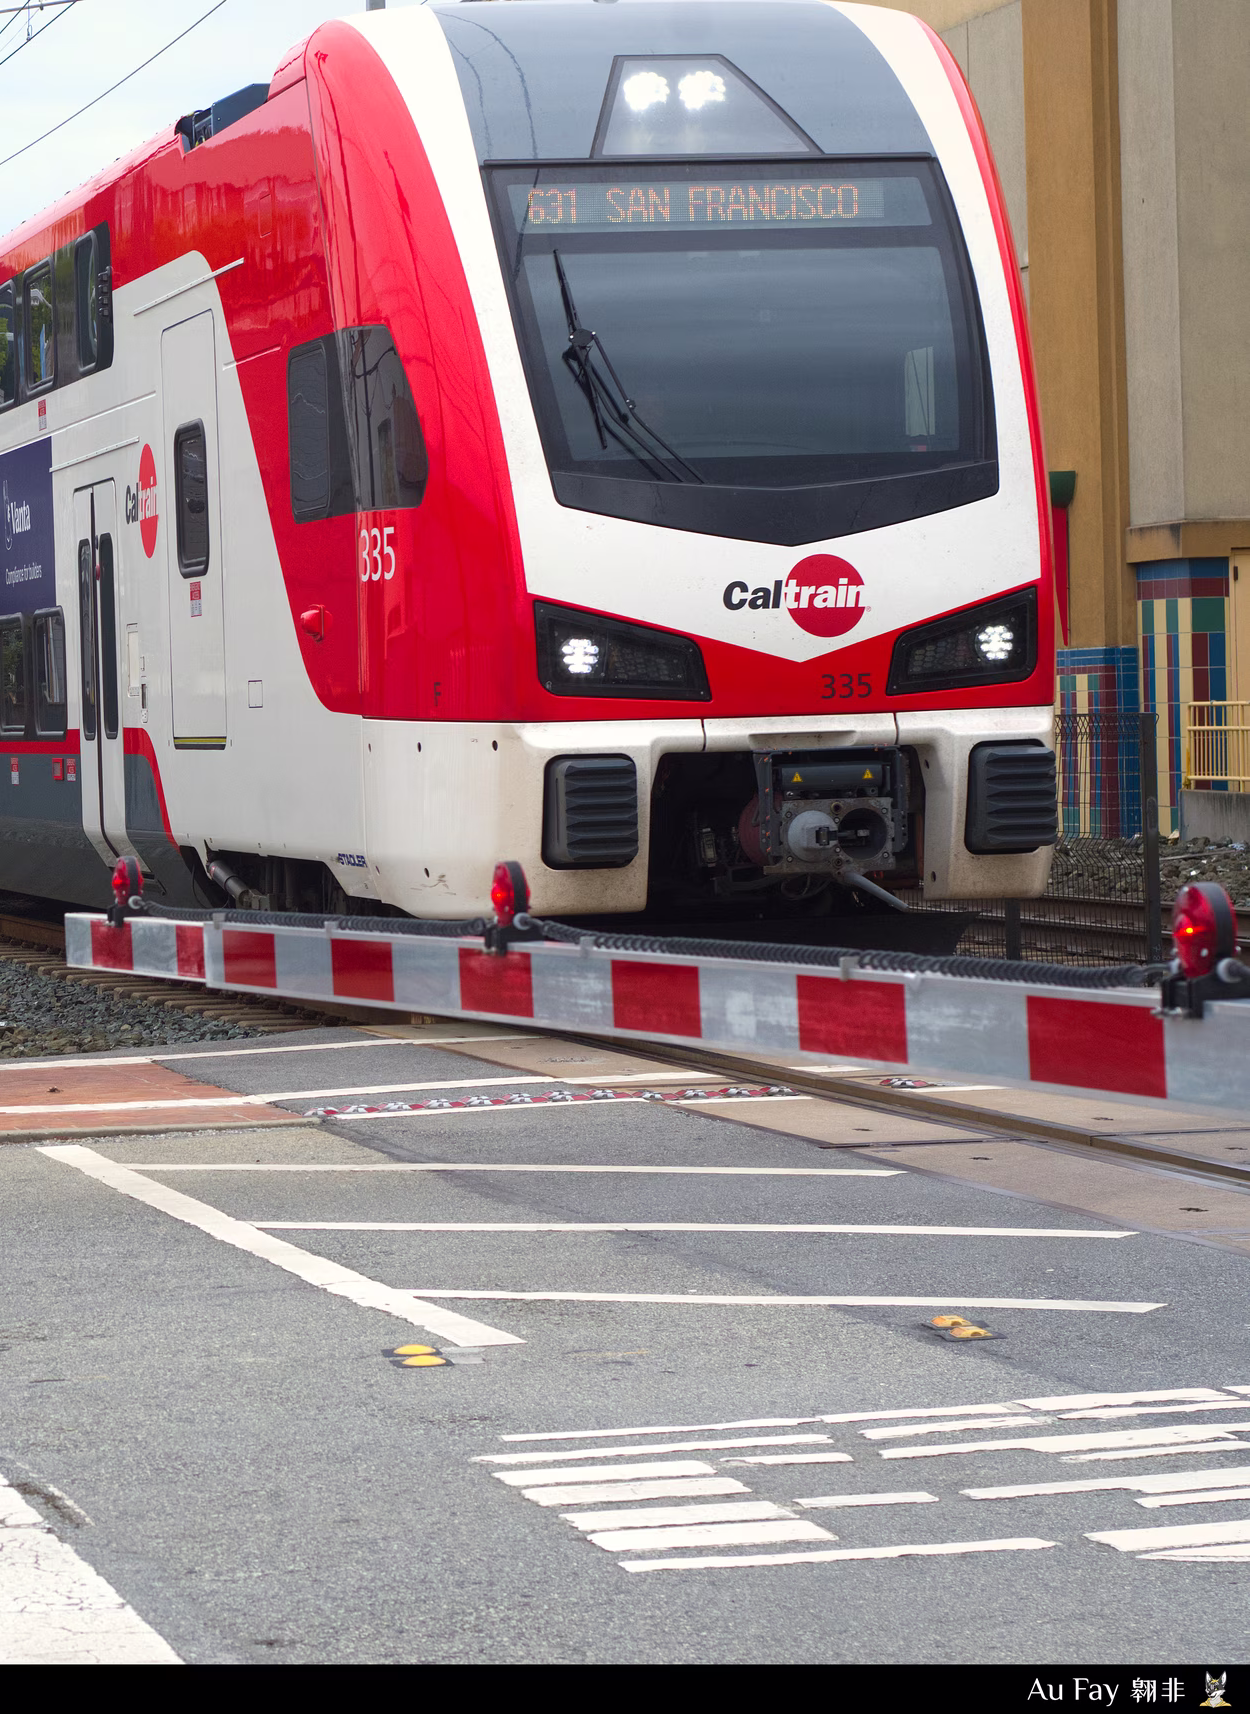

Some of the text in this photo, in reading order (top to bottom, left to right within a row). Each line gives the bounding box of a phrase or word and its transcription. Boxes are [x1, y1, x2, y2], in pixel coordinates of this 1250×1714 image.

[527, 184, 859, 224] 631 SAN FRANCISCO
[10, 500, 31, 535] Vanta
[125, 476, 157, 525] Caltrain
[360, 526, 396, 582] 335
[722, 577, 866, 611] Caltrain
[821, 673, 872, 699] 335
[337, 853, 368, 868] STADLER
